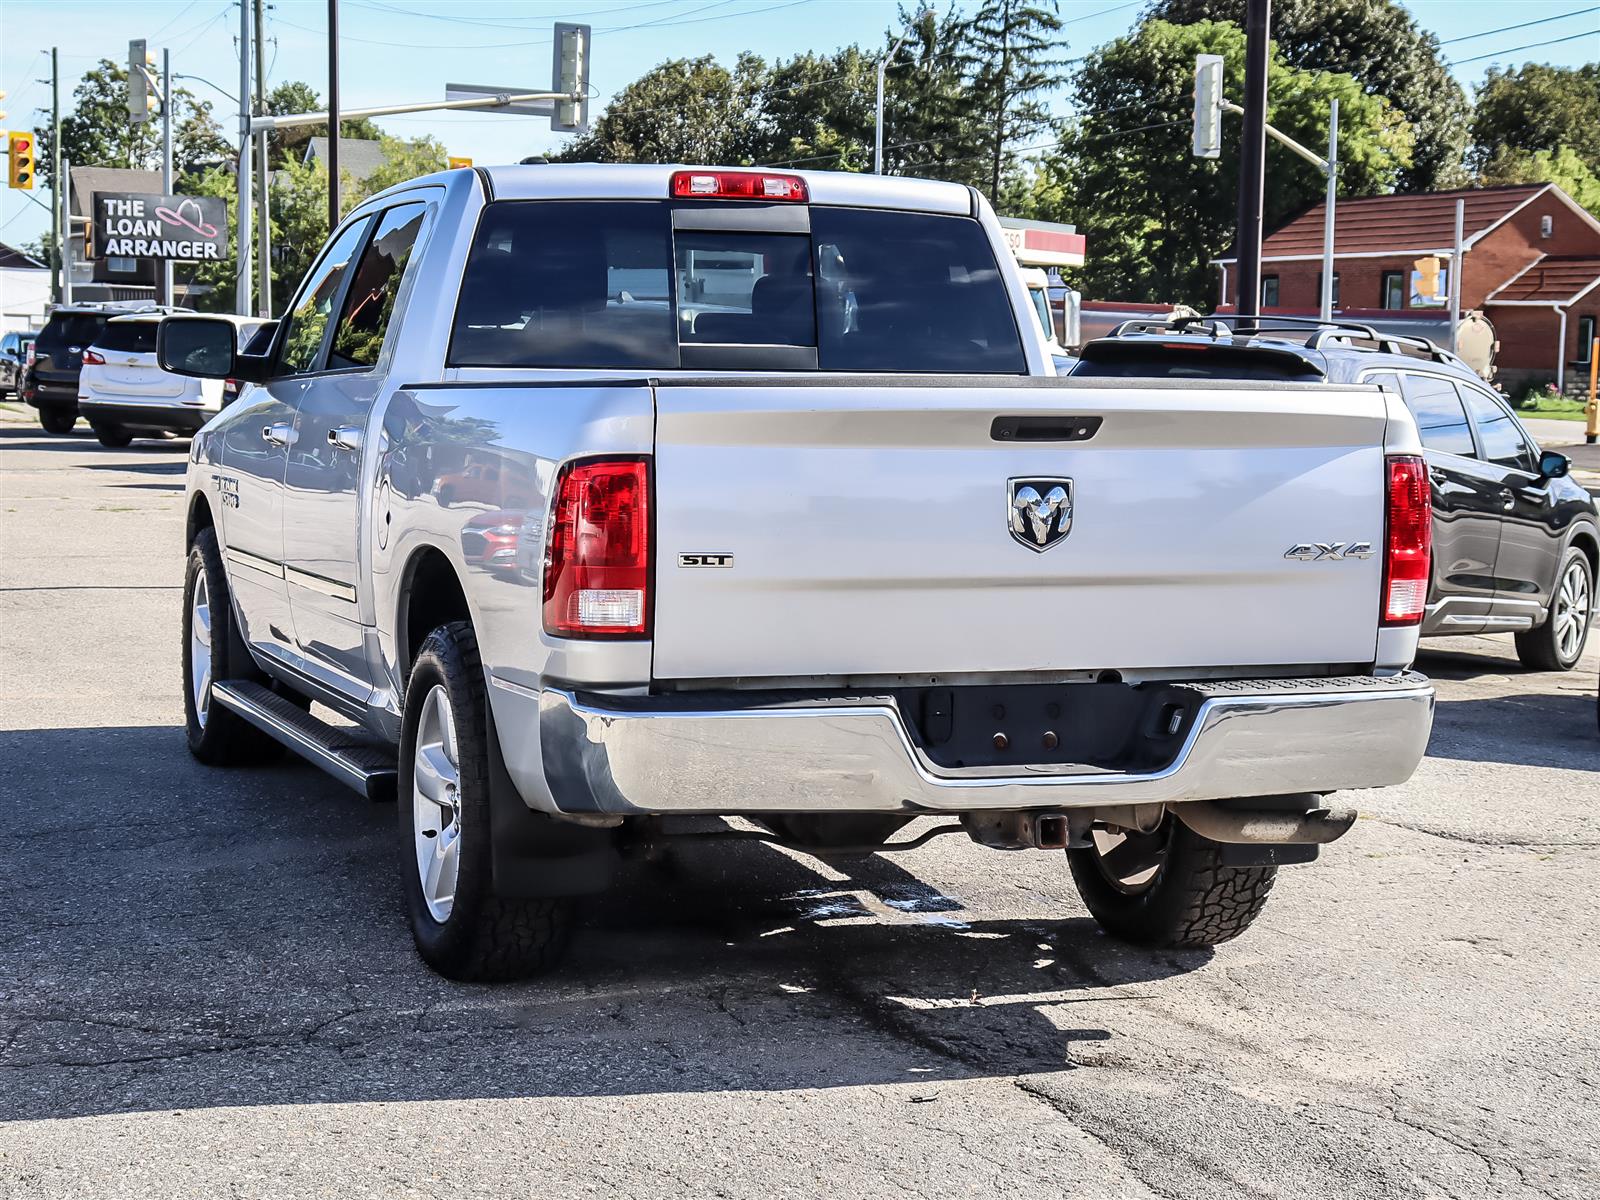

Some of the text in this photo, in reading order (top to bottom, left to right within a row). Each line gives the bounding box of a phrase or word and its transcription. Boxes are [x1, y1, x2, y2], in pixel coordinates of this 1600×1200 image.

[103, 199, 145, 217] THE
[106, 218, 162, 237] LOAN
[105, 238, 219, 259] ARRANGER
[680, 554, 734, 566] SLT
[1283, 541, 1376, 561] 4X4
